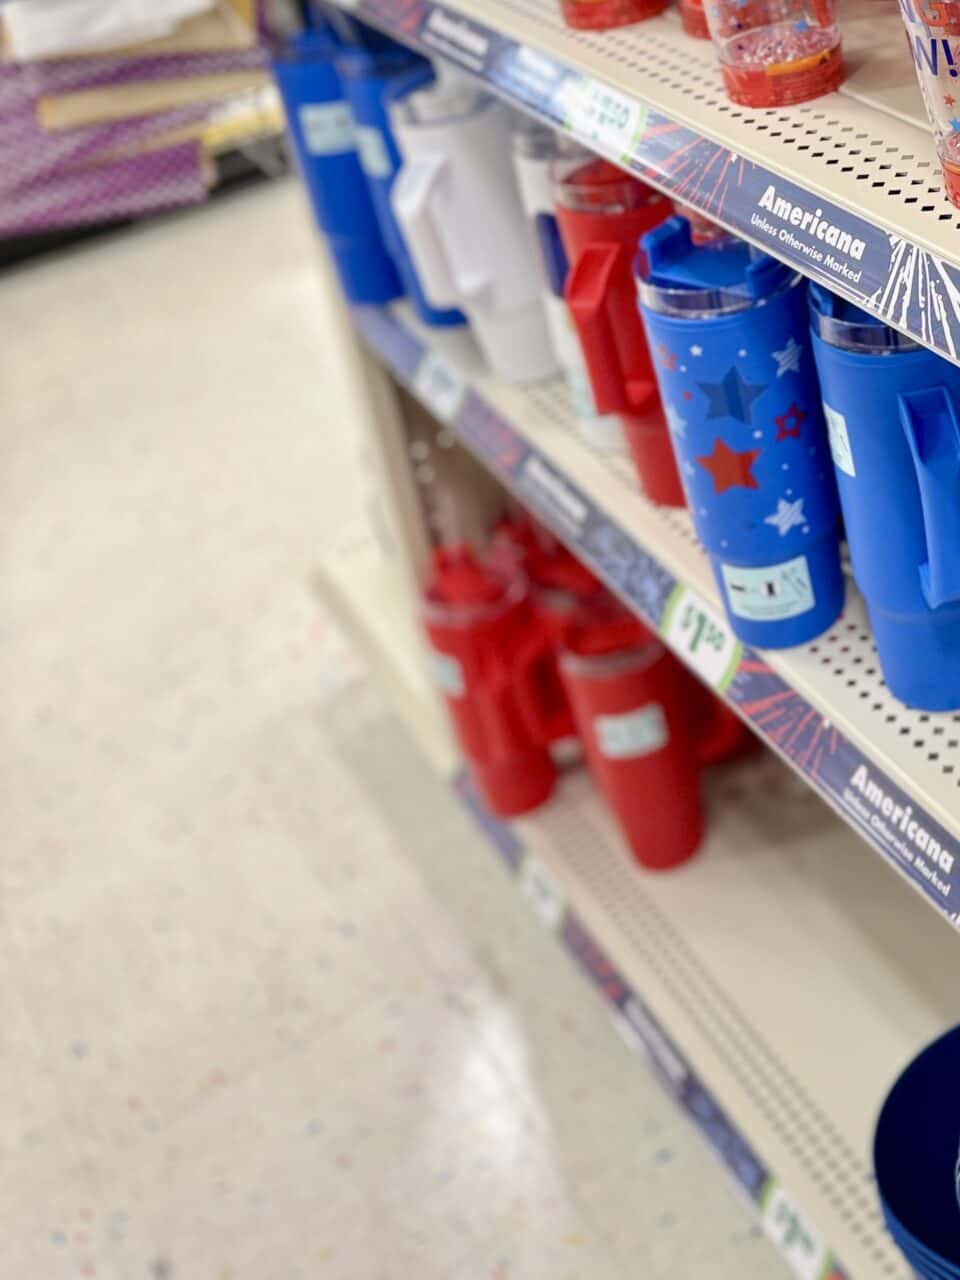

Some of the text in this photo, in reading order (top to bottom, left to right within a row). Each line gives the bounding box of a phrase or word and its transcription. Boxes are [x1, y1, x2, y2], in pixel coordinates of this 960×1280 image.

[750, 213, 862, 283] Unless Otherwise Marked
[758, 185, 867, 261] Americana
[850, 764, 956, 874] Americana
[913, 856, 951, 897] Marked
